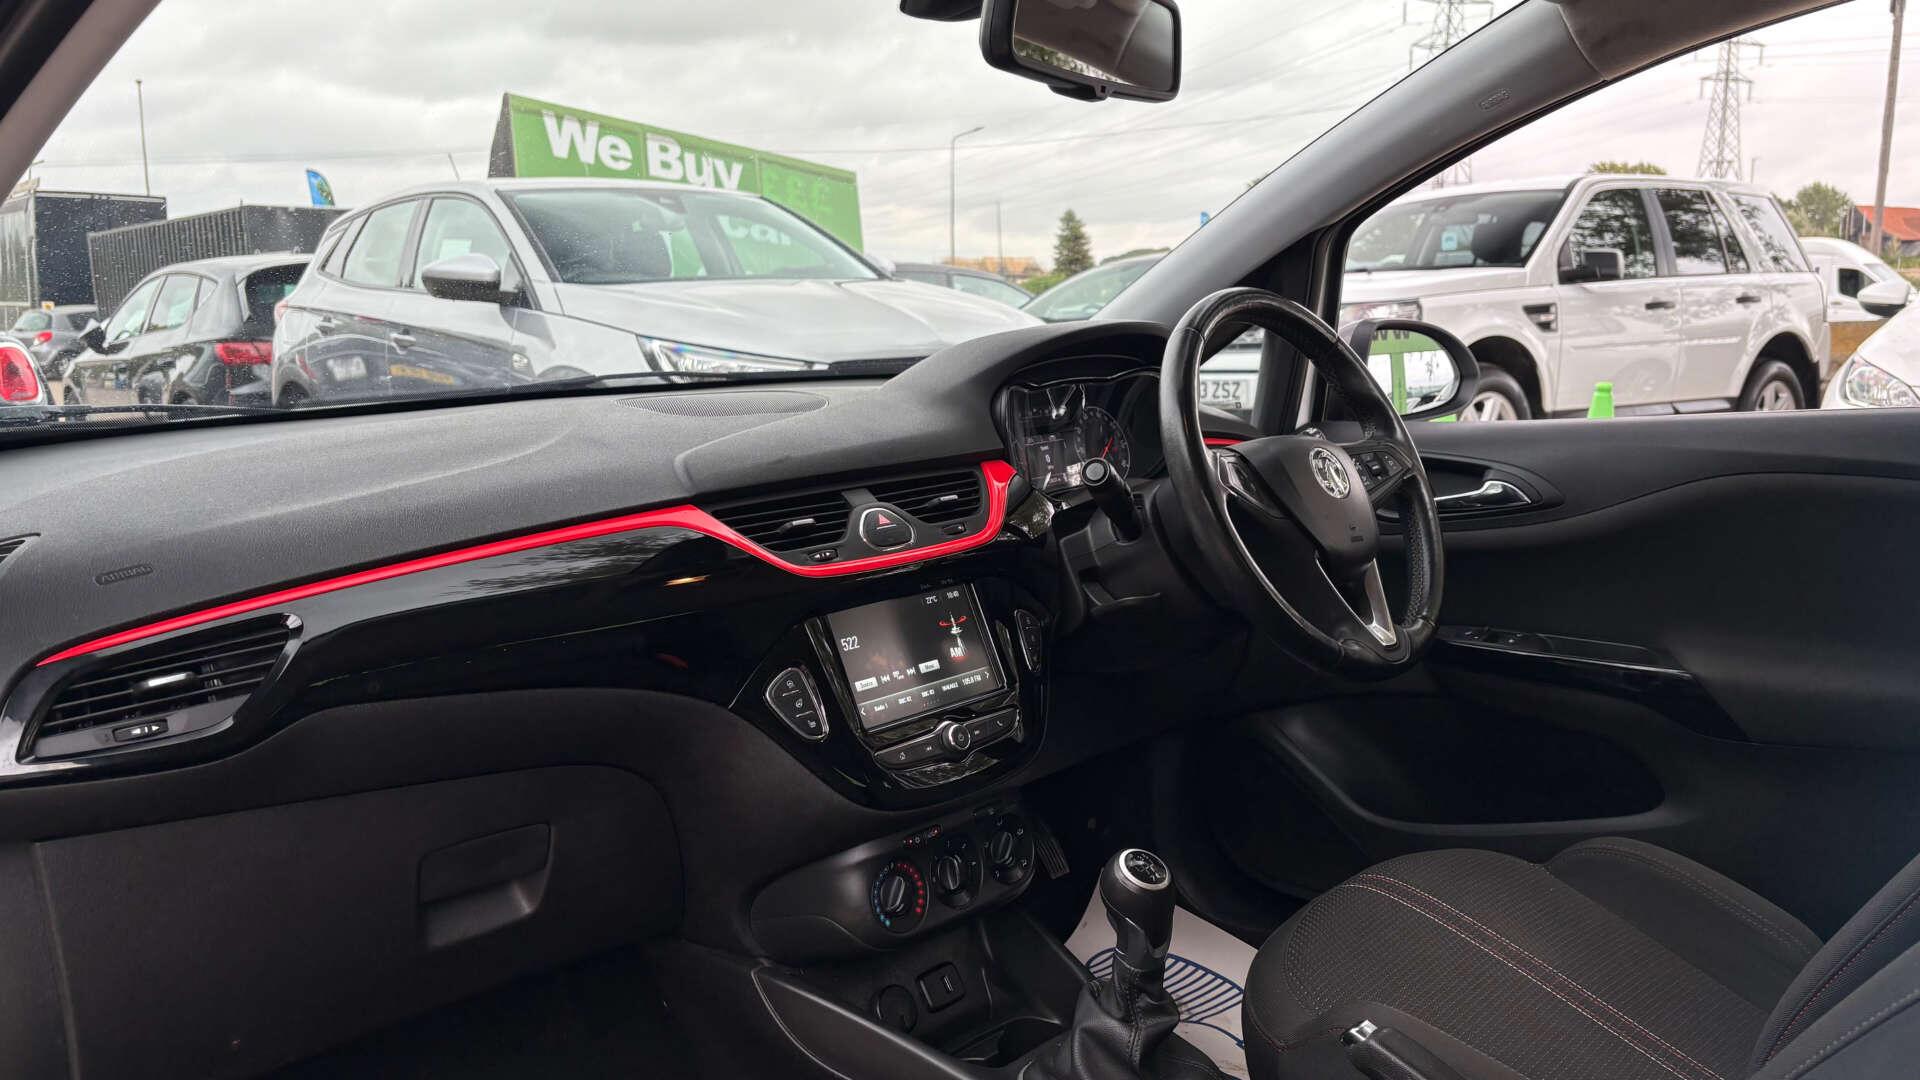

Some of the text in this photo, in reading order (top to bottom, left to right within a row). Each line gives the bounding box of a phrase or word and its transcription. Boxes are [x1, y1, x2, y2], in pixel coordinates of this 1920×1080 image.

[543, 109, 633, 171] We
[1212, 381, 1241, 400] ZSZ
[841, 635, 860, 652] 522
[950, 647, 964, 658] AM
